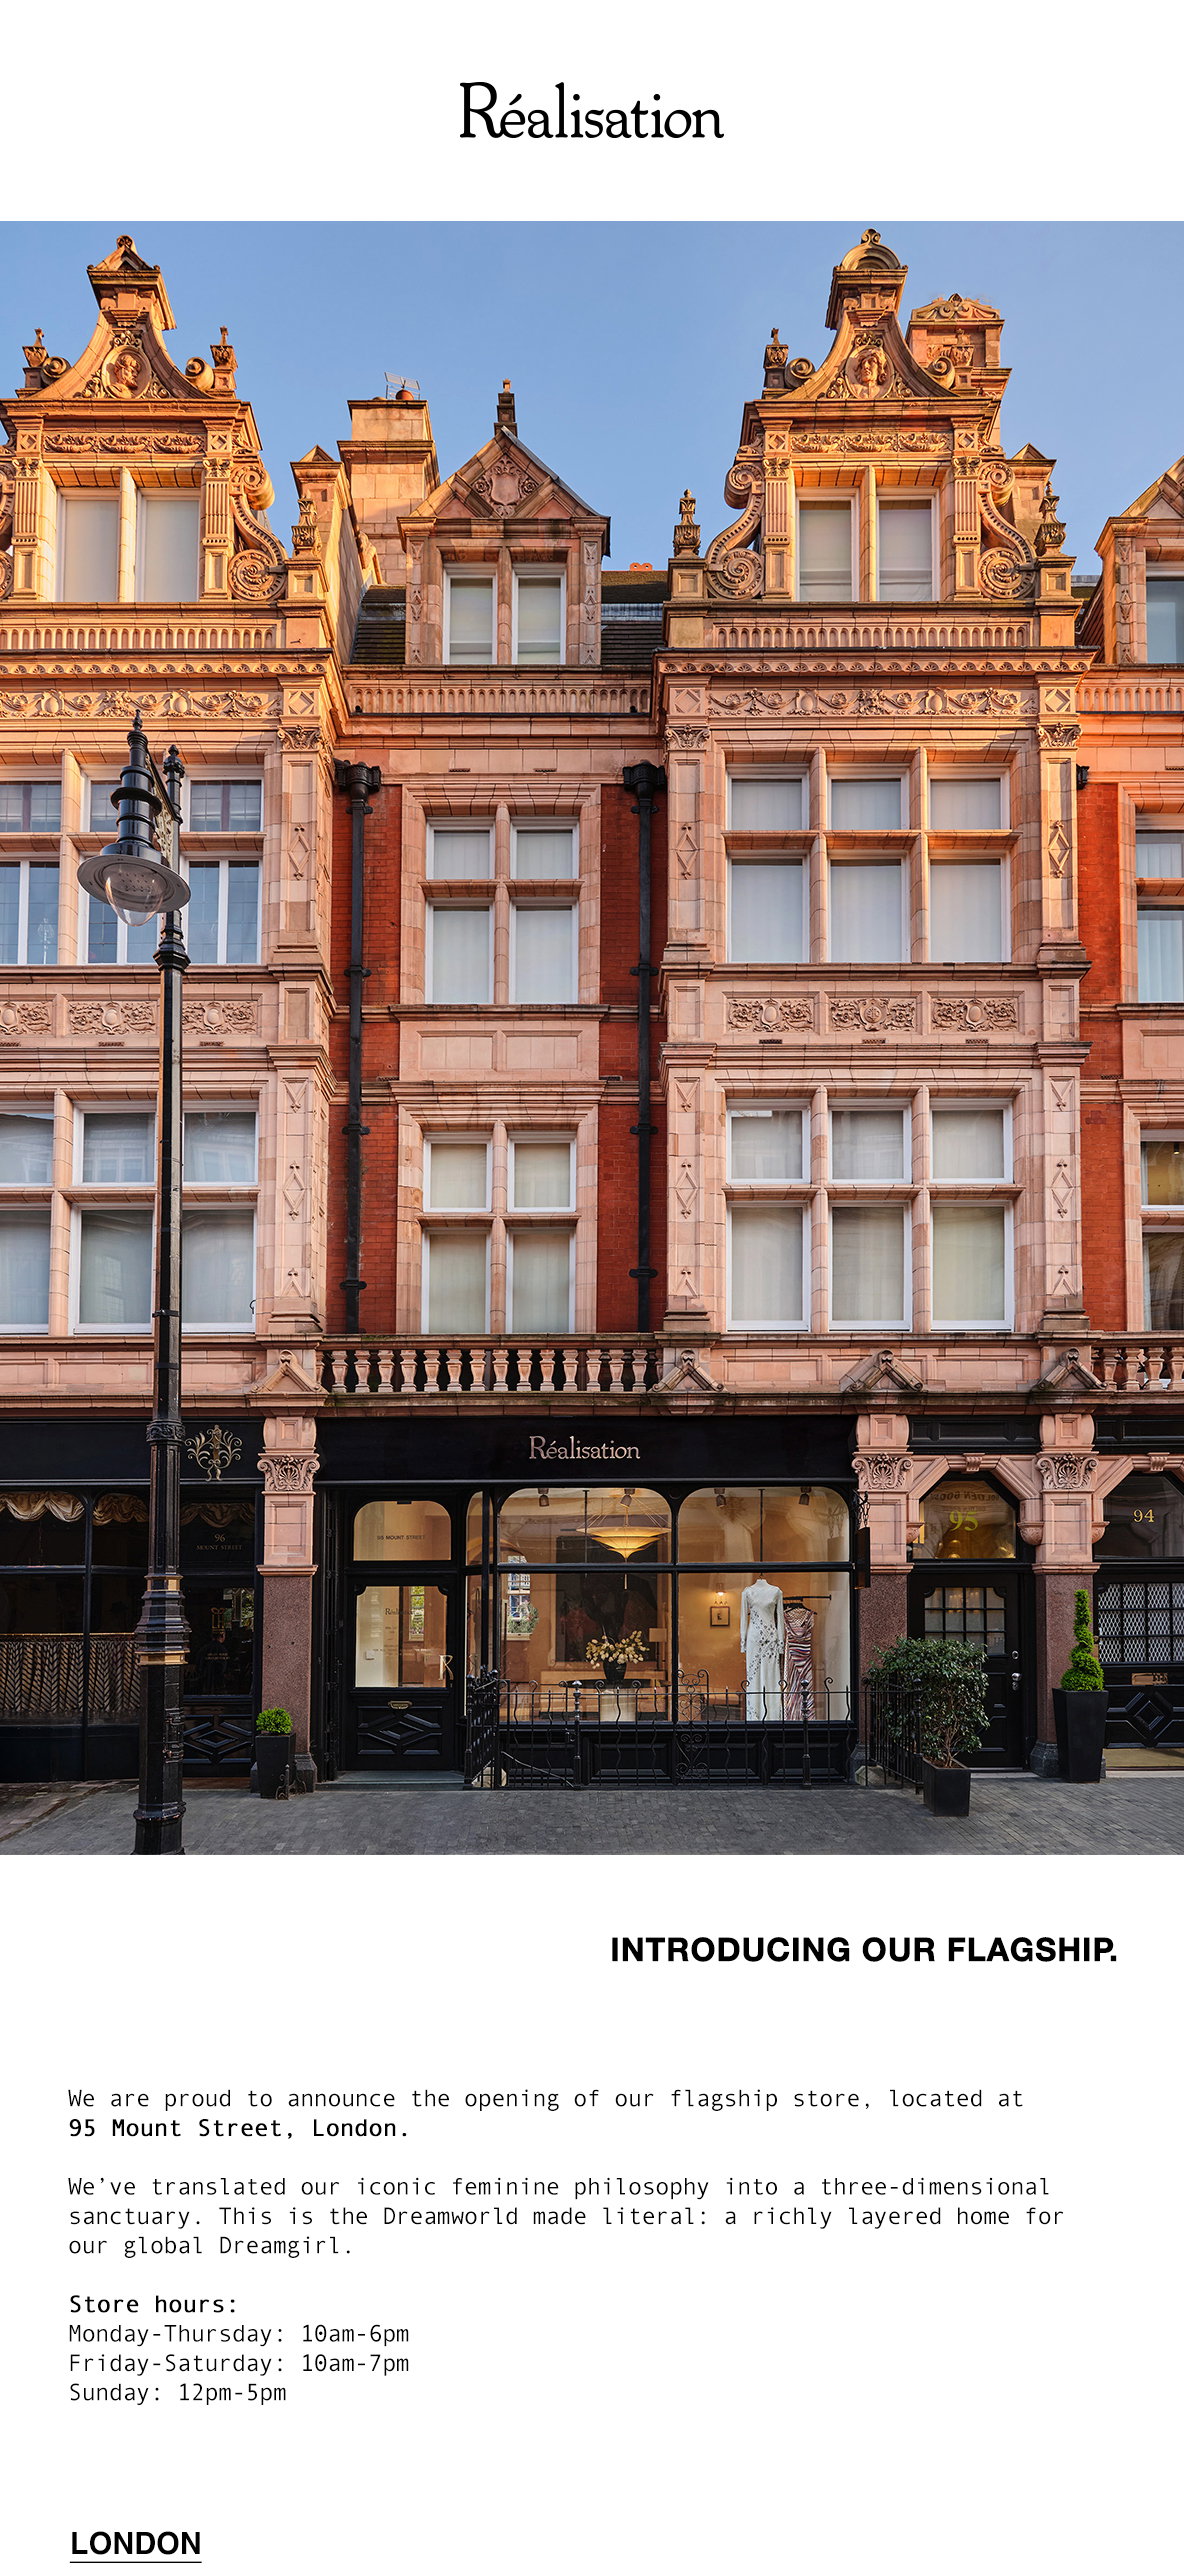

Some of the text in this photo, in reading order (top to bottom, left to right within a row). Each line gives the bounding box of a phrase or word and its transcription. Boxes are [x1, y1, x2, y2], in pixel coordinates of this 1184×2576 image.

[529, 1435, 641, 1460] Réalisation
[949, 1510, 979, 1532] 95
[1133, 1509, 1155, 1523] 94
[214, 1533, 226, 1543] 96
